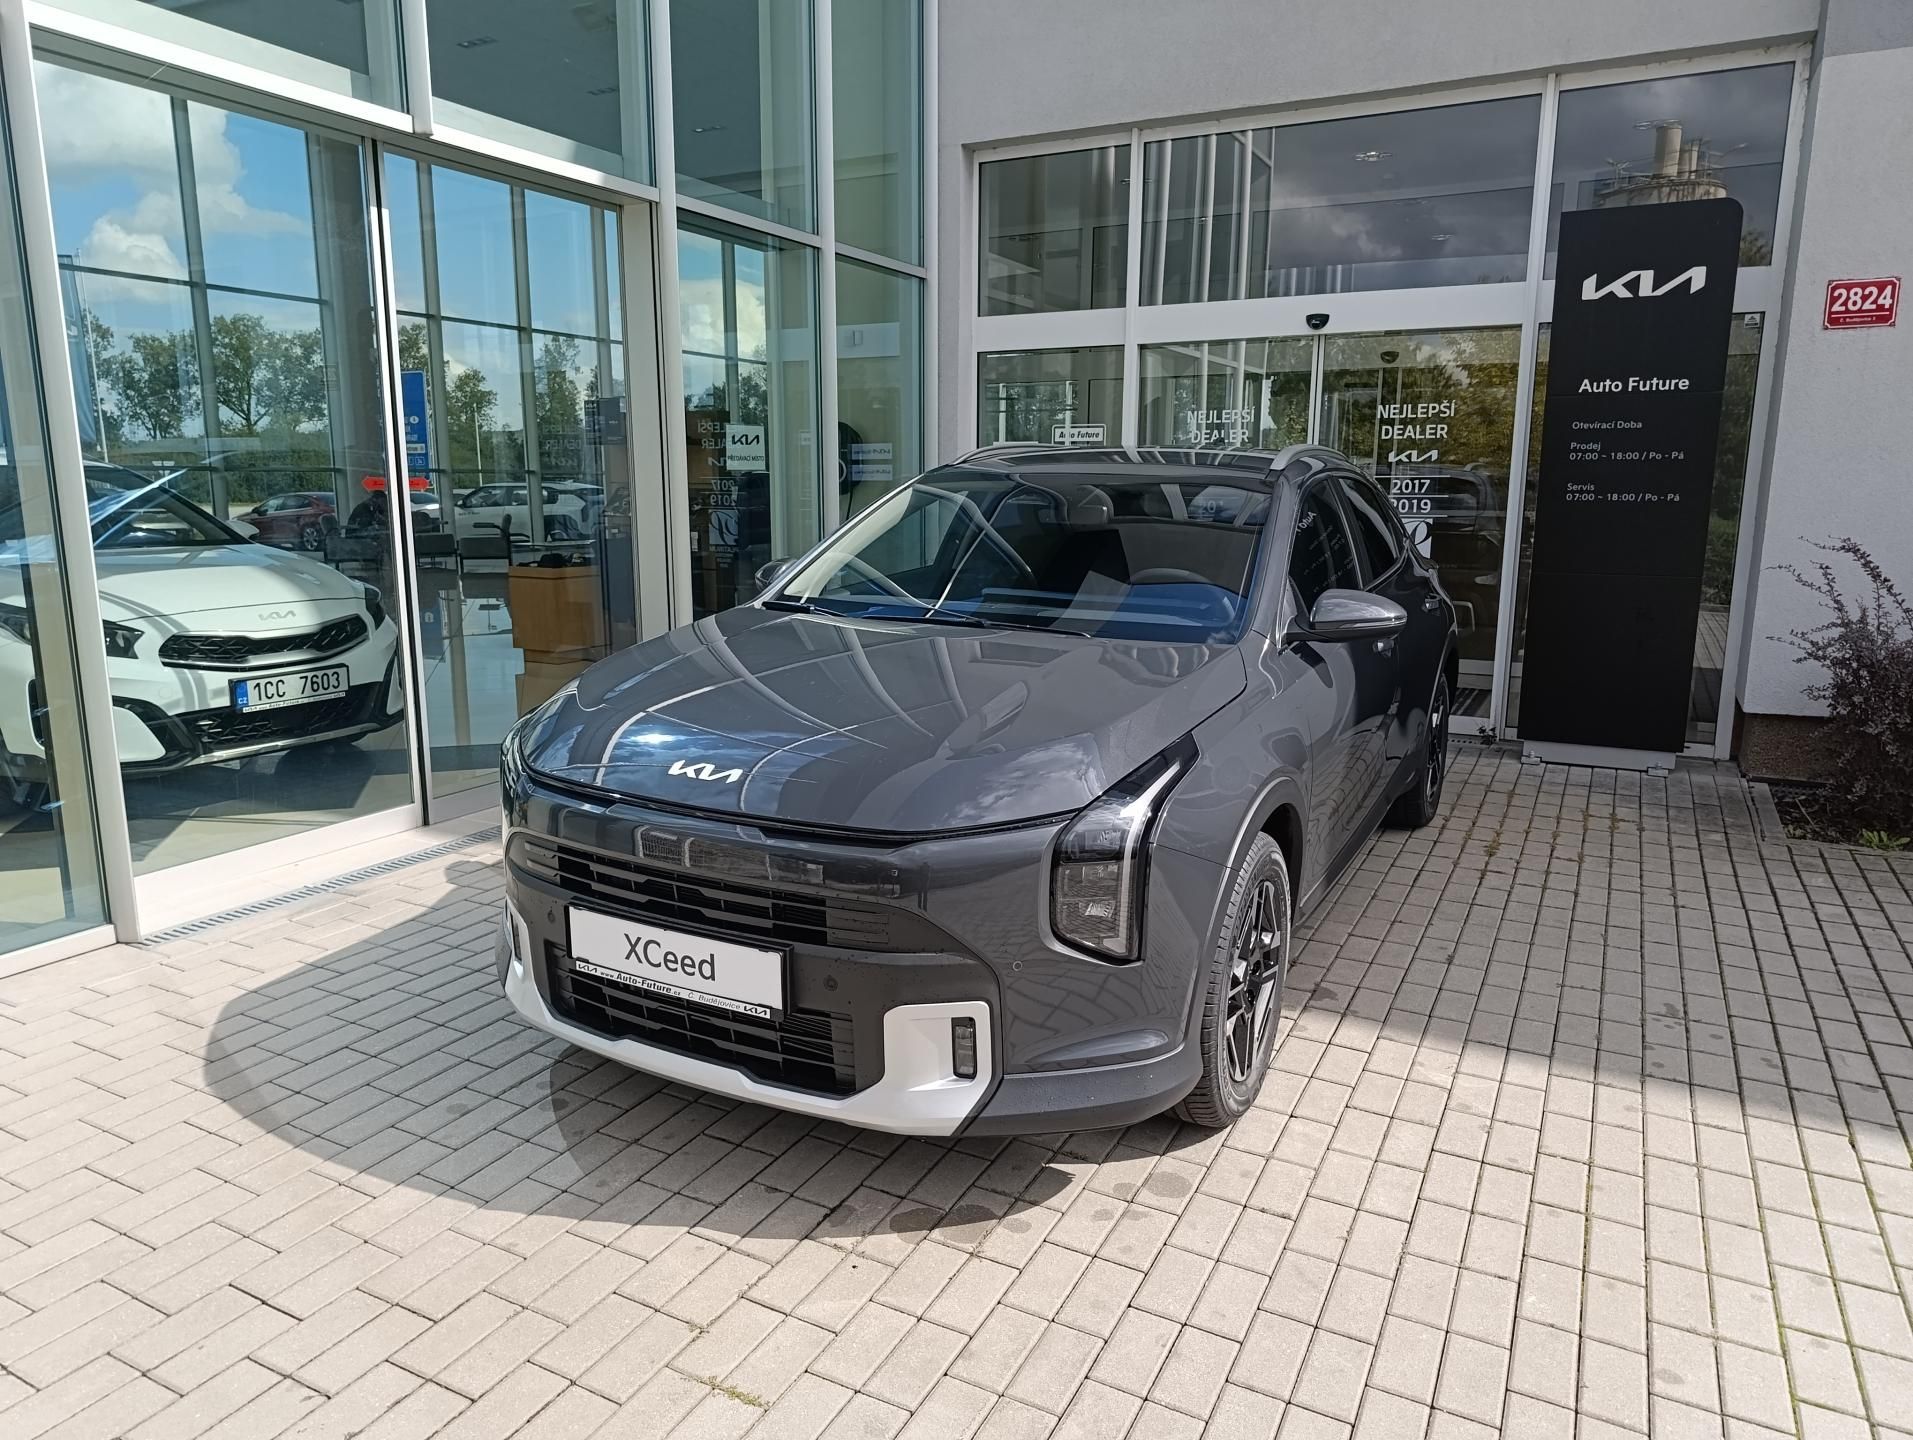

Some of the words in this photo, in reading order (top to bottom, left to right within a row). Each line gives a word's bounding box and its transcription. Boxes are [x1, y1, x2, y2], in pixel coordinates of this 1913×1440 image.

[1582, 266, 1706, 300] KIA
[1831, 285, 1892, 311] 2824
[1579, 379, 1622, 393] Auto
[1628, 377, 1689, 391] Future
[1377, 400, 1455, 419] NEJLEPŠÍ
[1381, 425, 1448, 439] DEALER
[1617, 421, 1642, 429] Doba
[732, 434, 760, 445] KIA
[1191, 429, 1249, 443] DEALER
[1570, 442, 1601, 452] Prodej
[1388, 450, 1438, 462] KIA
[1569, 452, 1598, 460] 07:00
[1611, 452, 1639, 460] 18:00
[1649, 451, 1662, 460] Po
[1671, 450, 1684, 459] Pá
[1392, 480, 1431, 493] 2017
[1567, 482, 1595, 491] Servis
[1566, 493, 1595, 501] 07:00
[1607, 493, 1635, 501] 18:00
[1645, 492, 1658, 501] Po
[1667, 492, 1680, 501] Pá
[254, 679, 285, 700] 1CC
[300, 671, 340, 695] 7603
[668, 760, 743, 784] KIA
[624, 933, 716, 981] XCeed
[578, 963, 598, 973] KIA
[699, 994, 741, 1010] Budějovice
[744, 1005, 767, 1015] KIA
